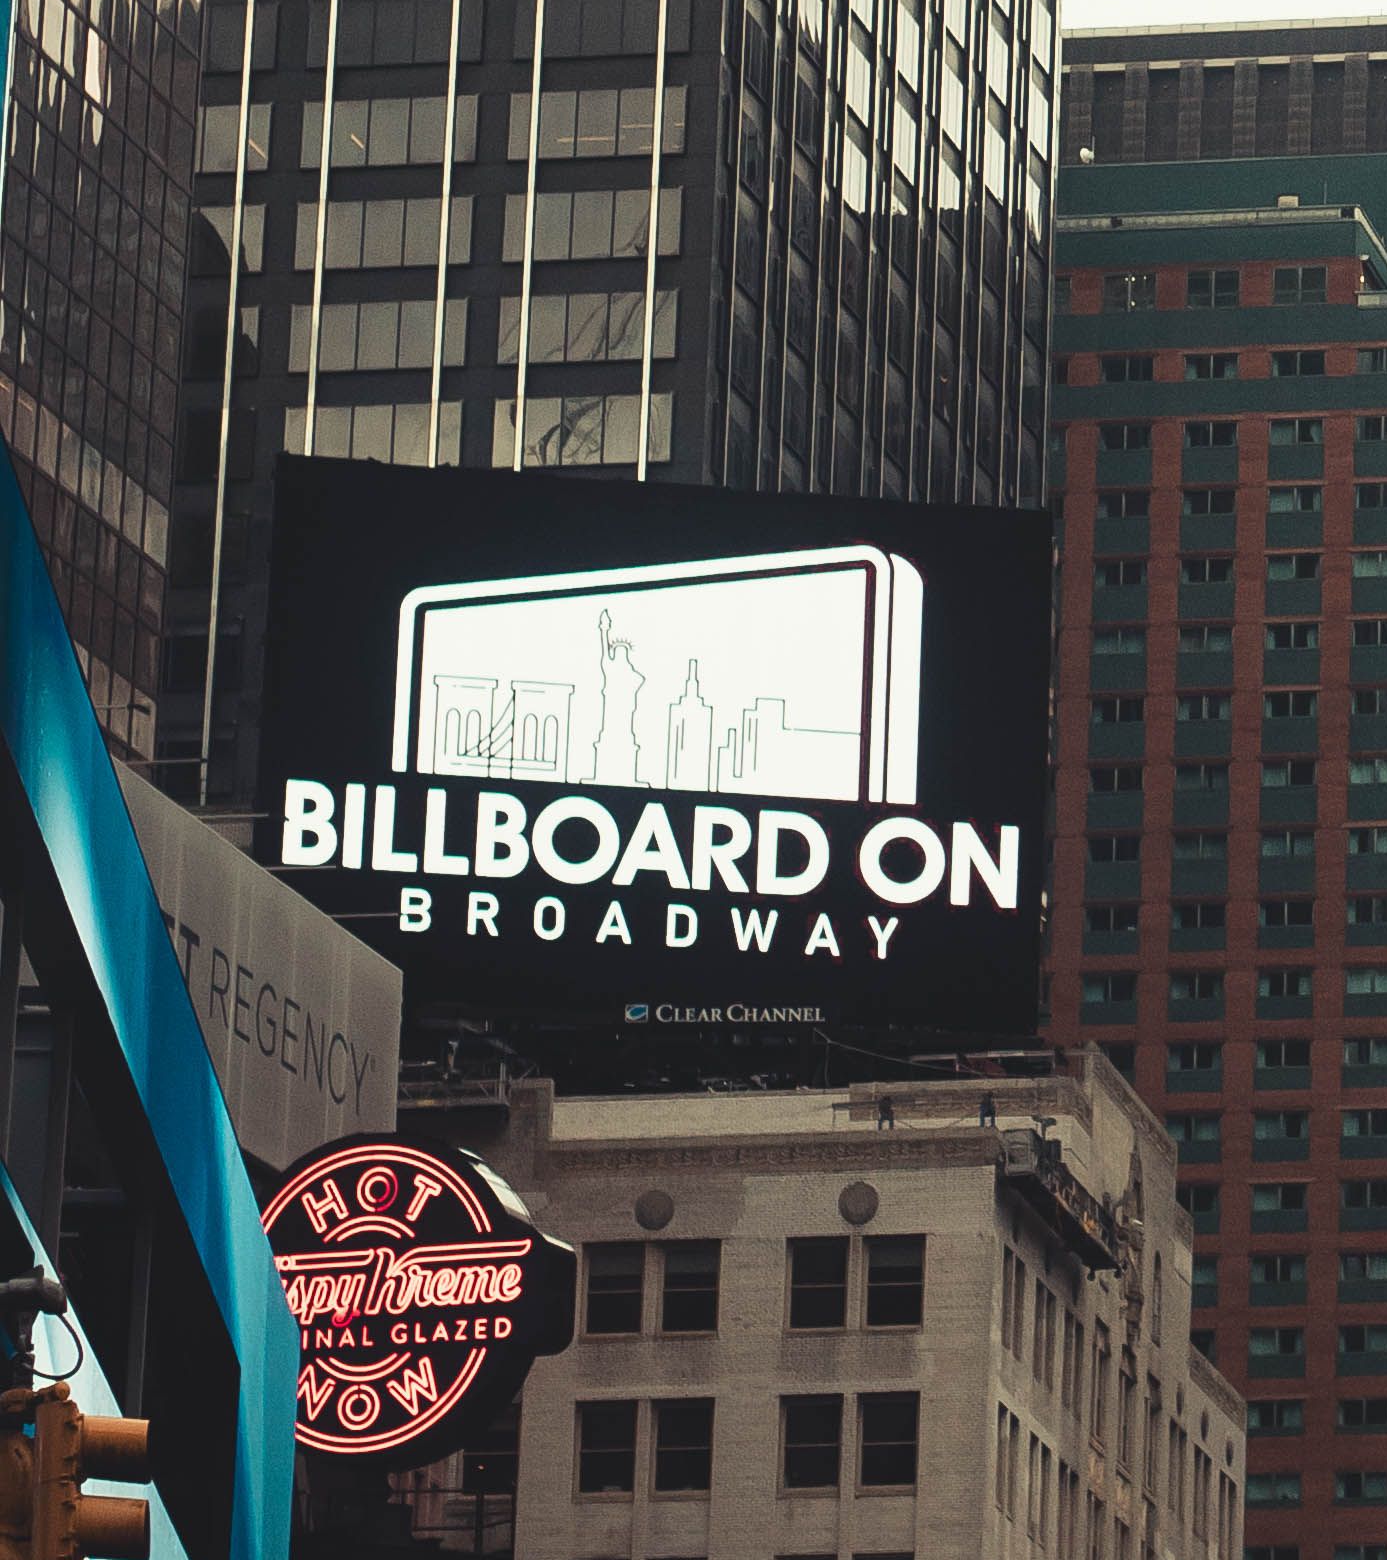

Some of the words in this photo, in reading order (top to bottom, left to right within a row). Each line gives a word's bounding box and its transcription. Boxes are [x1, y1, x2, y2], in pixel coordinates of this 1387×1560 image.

[280, 776, 830, 897] BILLBOARD
[858, 816, 1020, 910] ON
[398, 886, 900, 961] BROADWAY
[207, 946, 369, 1117] REGENCY
[301, 1165, 443, 1235] HOT
[364, 1246, 523, 1316] Kreme
[390, 1316, 513, 1346] GLAZED
[296, 1356, 439, 1431] NOW
